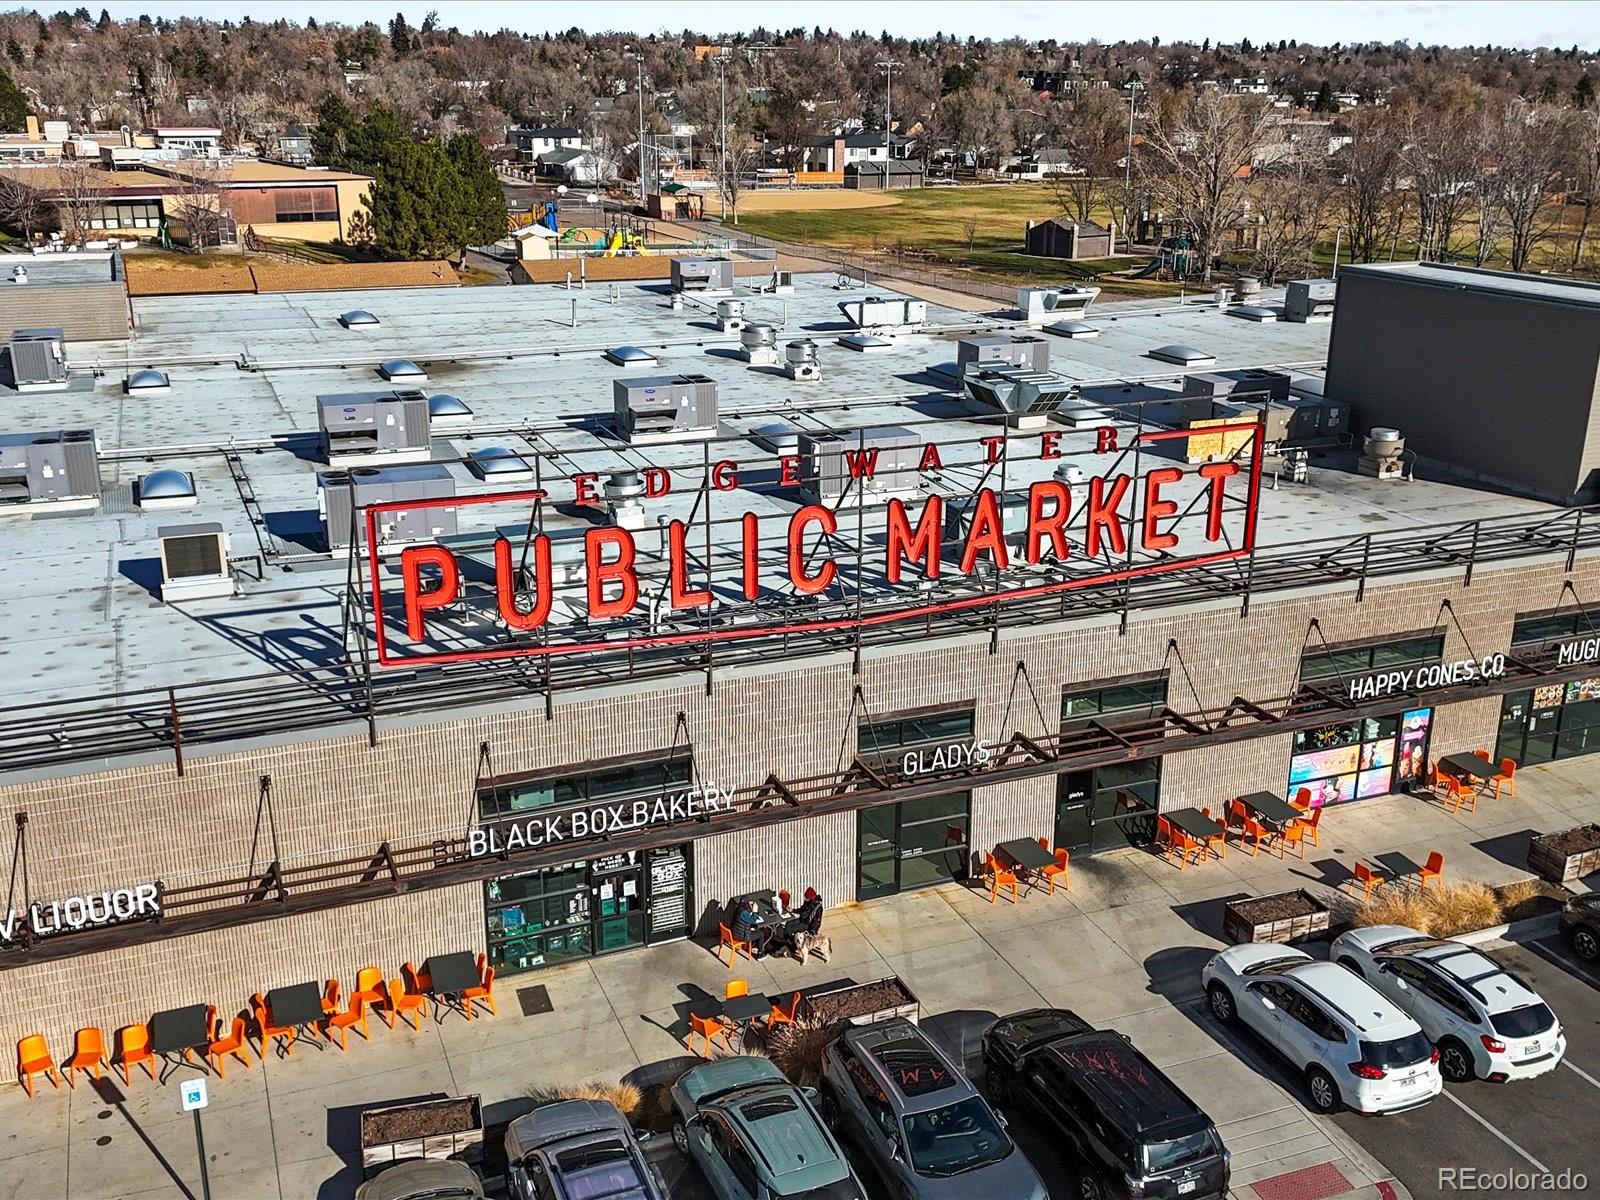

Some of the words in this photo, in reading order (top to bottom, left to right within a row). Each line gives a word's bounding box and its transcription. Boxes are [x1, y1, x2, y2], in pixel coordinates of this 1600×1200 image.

[576, 427, 1119, 506] EDGEWATER
[401, 505, 838, 640] PUBLIC
[886, 461, 1239, 583] MARKET
[1349, 669, 1413, 700] HAPPY
[1416, 659, 1476, 689] CONES
[903, 740, 990, 775] GLADYS
[469, 815, 563, 857] BLACK
[571, 803, 624, 838] BOX
[632, 785, 736, 828] BAKERY
[31, 884, 160, 934] LIQUOR
